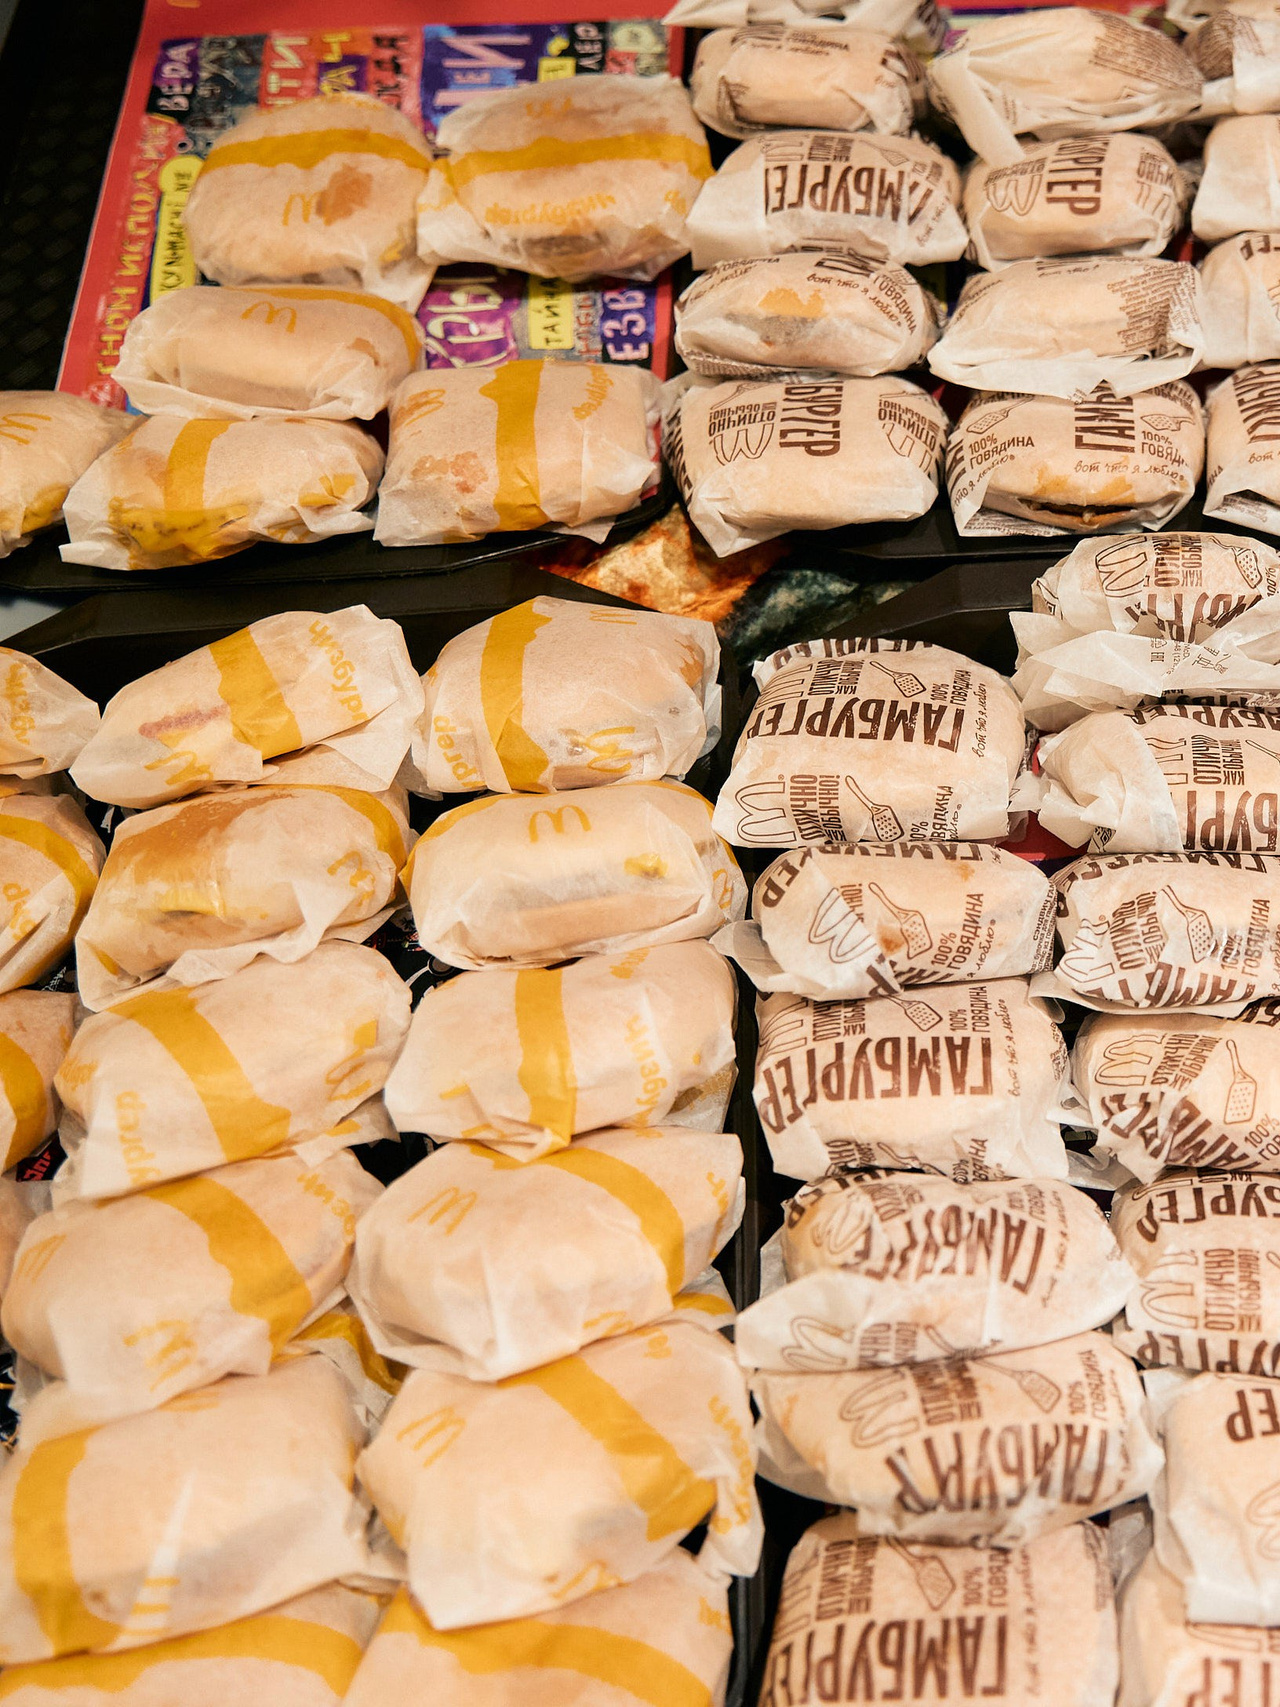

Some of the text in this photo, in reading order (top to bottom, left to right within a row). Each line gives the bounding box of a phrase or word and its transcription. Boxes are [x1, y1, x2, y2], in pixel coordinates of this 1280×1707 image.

[968, 434, 998, 454] 100%
[969, 436, 1035, 470] ГОВЯДИНА
[1141, 431, 1173, 446] 100%
[1248, 451, 1275, 464] вот
[1181, 571, 1202, 587] КАК
[930, 682, 950, 702] 100%
[1191, 735, 1222, 785] ОТЛИЧНО
[1223, 771, 1246, 786] КАК
[789, 774, 817, 841] ОТЛИЧНО
[819, 774, 840, 826] ОБЫЧНО!
[948, 892, 984, 970] ГОВЯДИНА
[1240, 899, 1271, 979] ГОВЯДИНА
[931, 932, 956, 968] 100%
[949, 1009, 967, 1032] 100%
[969, 986, 987, 1034] ГОВЯДИНА
[843, 1023, 866, 1036] КАК
[762, 1036, 994, 1134] ГАМБУРГЕР
[1244, 1112, 1280, 1148] 100%
[1204, 1248, 1235, 1331] ОТЛИЧНО
[1237, 1248, 1261, 1315] ОБЫЧНО!
